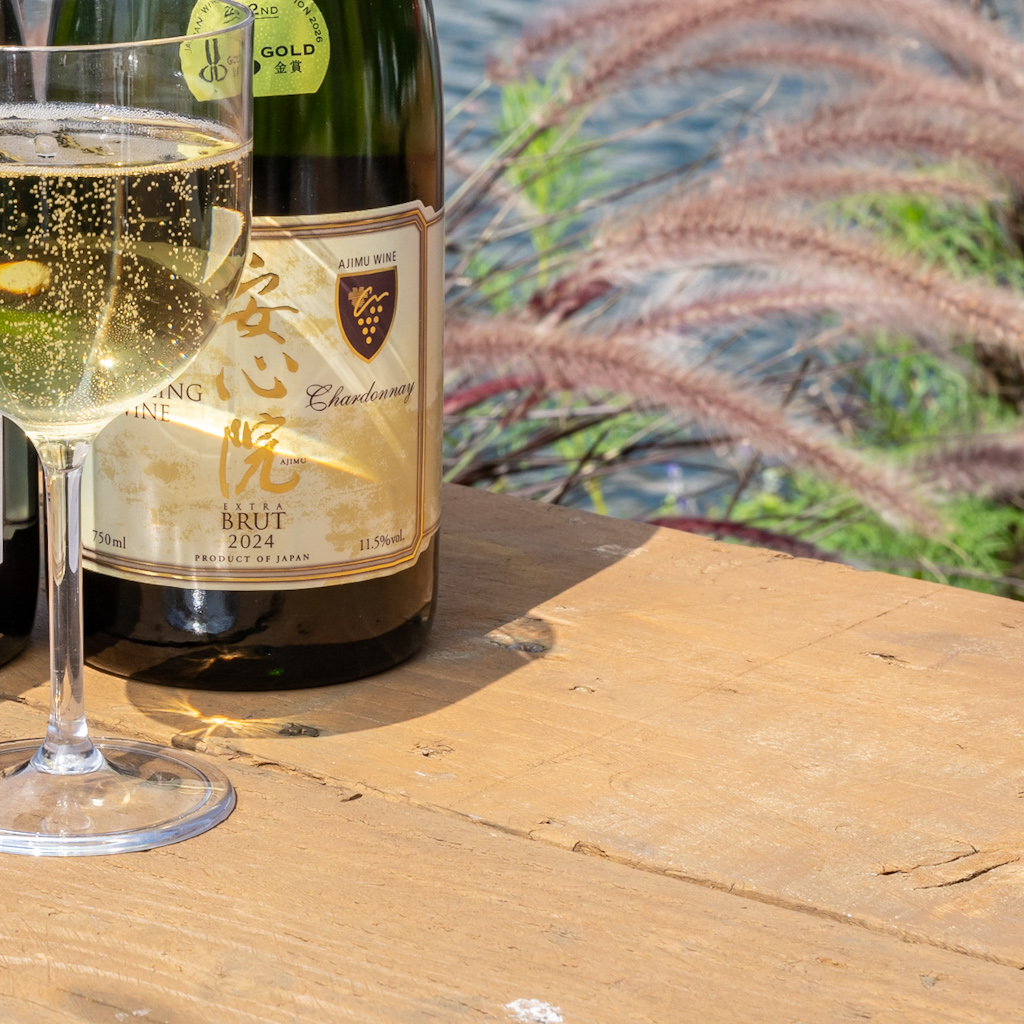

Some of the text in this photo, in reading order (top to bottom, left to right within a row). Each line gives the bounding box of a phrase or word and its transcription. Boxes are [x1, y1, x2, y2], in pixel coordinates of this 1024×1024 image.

[308, 16, 323, 43] 2026
[260, 43, 316, 58] GOLD
[274, 59, 303, 75] 金賞
[337, 250, 397, 270] AJIMU WINE
[304, 380, 416, 412] Chardonnay
[279, 457, 307, 466] AJIMU
[223, 502, 284, 511] EXTRA
[221, 511, 287, 531] BRUT
[227, 533, 275, 550] 2024
[194, 552, 310, 564] PRODUCT OF JAPAN
